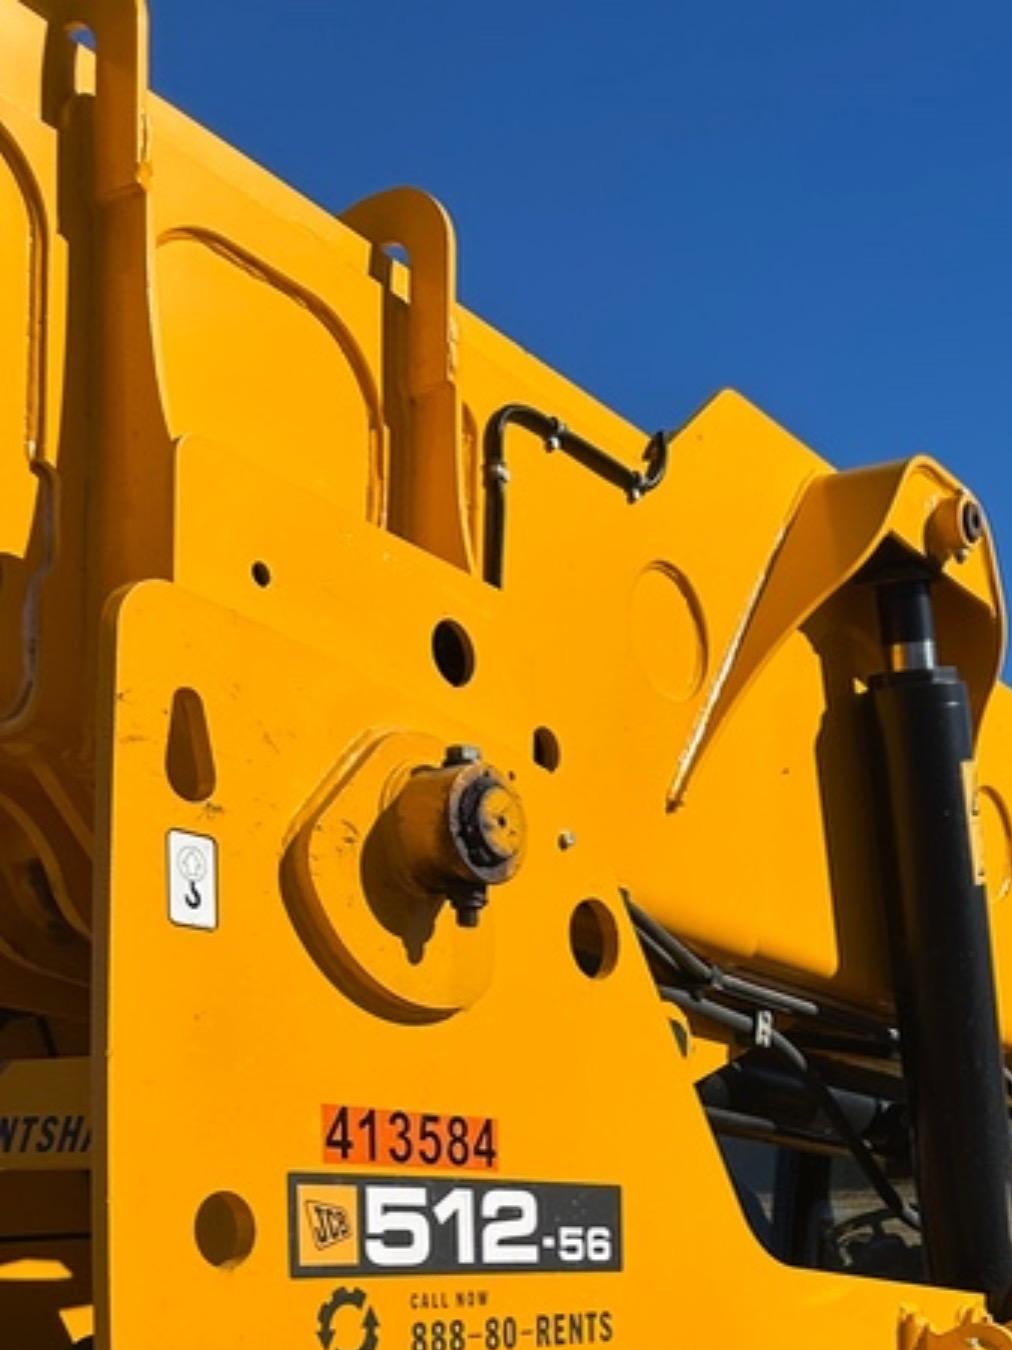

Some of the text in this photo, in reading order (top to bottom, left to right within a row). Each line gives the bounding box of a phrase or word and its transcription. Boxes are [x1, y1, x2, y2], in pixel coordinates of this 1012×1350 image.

[325, 1106, 497, 1168] 413584
[410, 1290, 489, 1309] CALL NOW
